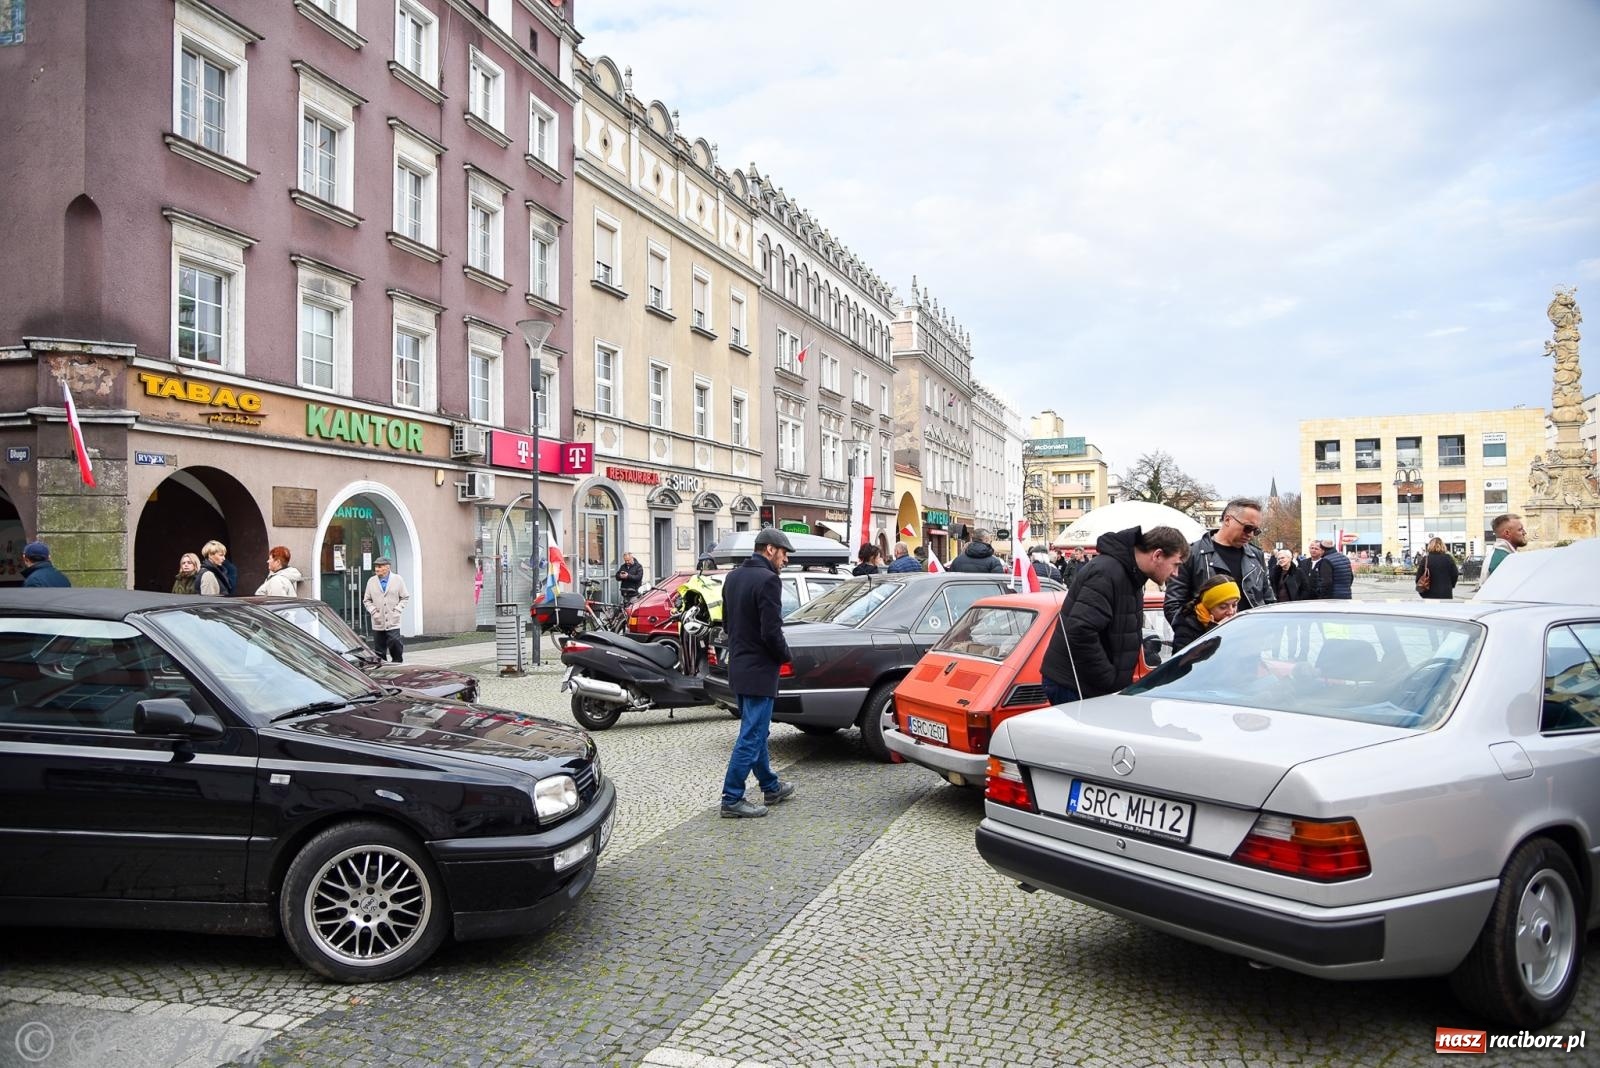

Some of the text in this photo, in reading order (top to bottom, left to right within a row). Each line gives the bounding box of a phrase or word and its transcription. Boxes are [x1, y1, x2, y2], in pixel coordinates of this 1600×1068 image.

[140, 372, 262, 412] TABAC
[306, 403, 424, 452] KANTOR
[610, 467, 700, 492] RESTAURACJA SHIRO
[912, 719, 928, 736] SRC
[1081, 786, 1184, 834] SRC MH12
